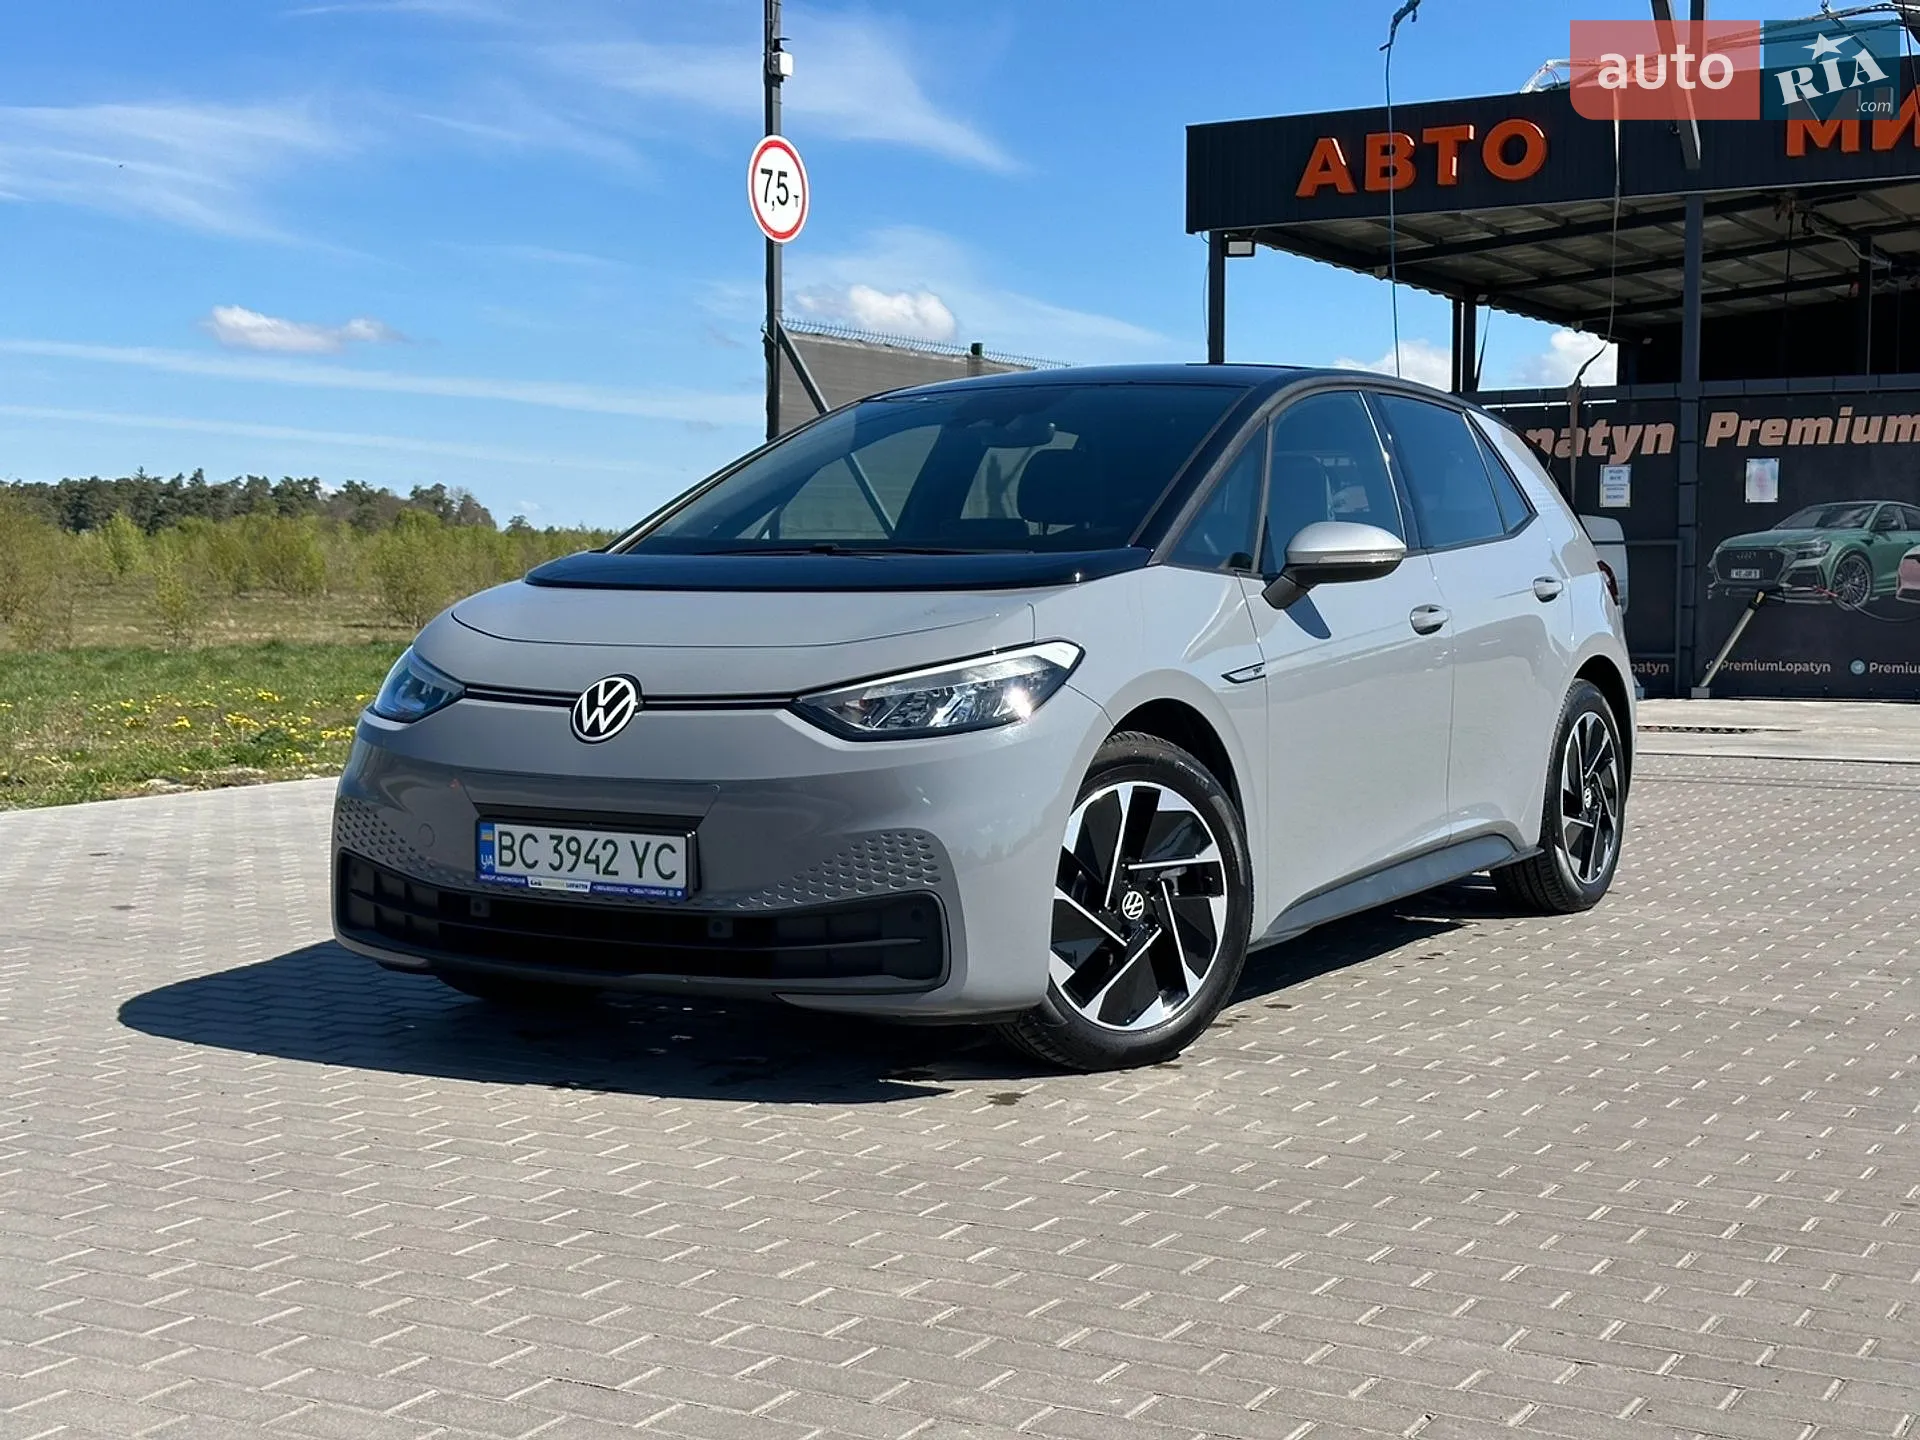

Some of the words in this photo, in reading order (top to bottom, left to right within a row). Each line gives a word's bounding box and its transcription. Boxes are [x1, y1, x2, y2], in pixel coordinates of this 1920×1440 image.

[1295, 118, 1548, 199] АВТО
[760, 167, 790, 212] 7,5
[1703, 406, 1920, 448] Premium
[1720, 659, 1832, 676] PremiumLopatyn
[1869, 661, 1920, 674] Premiu
[497, 830, 540, 870] BC
[548, 834, 620, 877] 3942
[630, 840, 678, 881] YC
